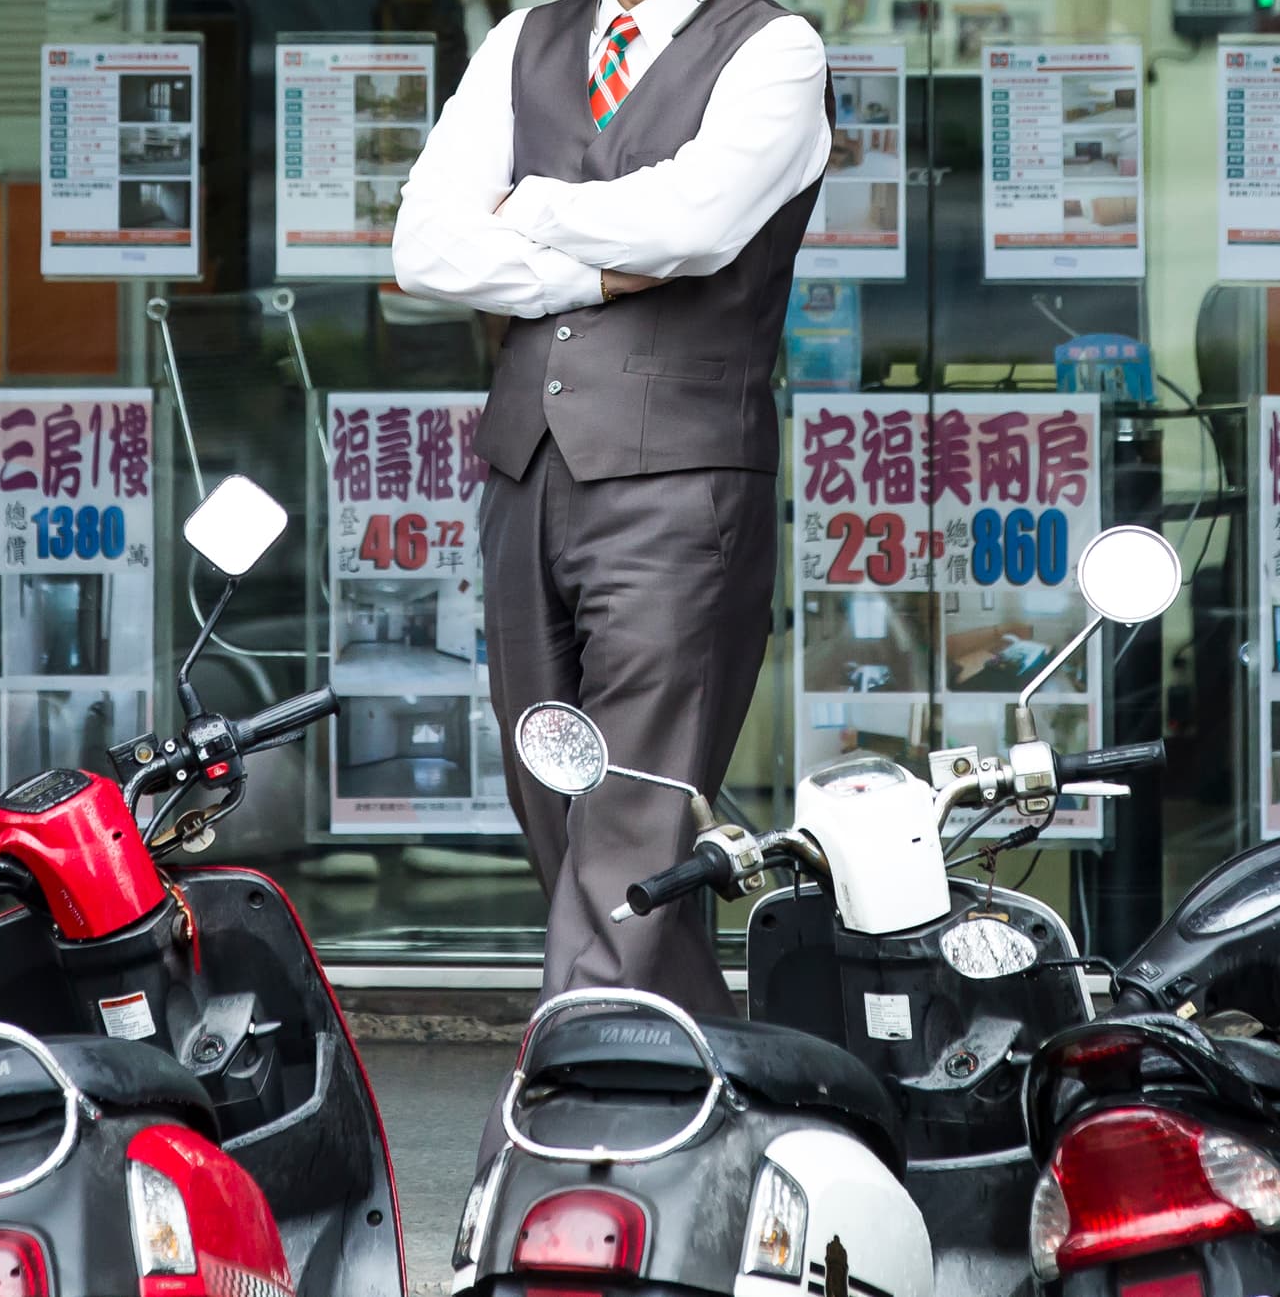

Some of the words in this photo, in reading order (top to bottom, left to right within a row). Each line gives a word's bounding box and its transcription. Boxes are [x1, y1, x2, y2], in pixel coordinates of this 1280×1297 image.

[803, 408, 1090, 506] 宏福美兩房
[4, 501, 28, 565] 總價
[31, 506, 125, 561] 1380
[337, 506, 361, 573] 登記
[801, 510, 825, 582] 登記
[945, 518, 970, 586] 總價
[971, 508, 1069, 586] 860
[598, 1027, 672, 1047] YAMAHA
